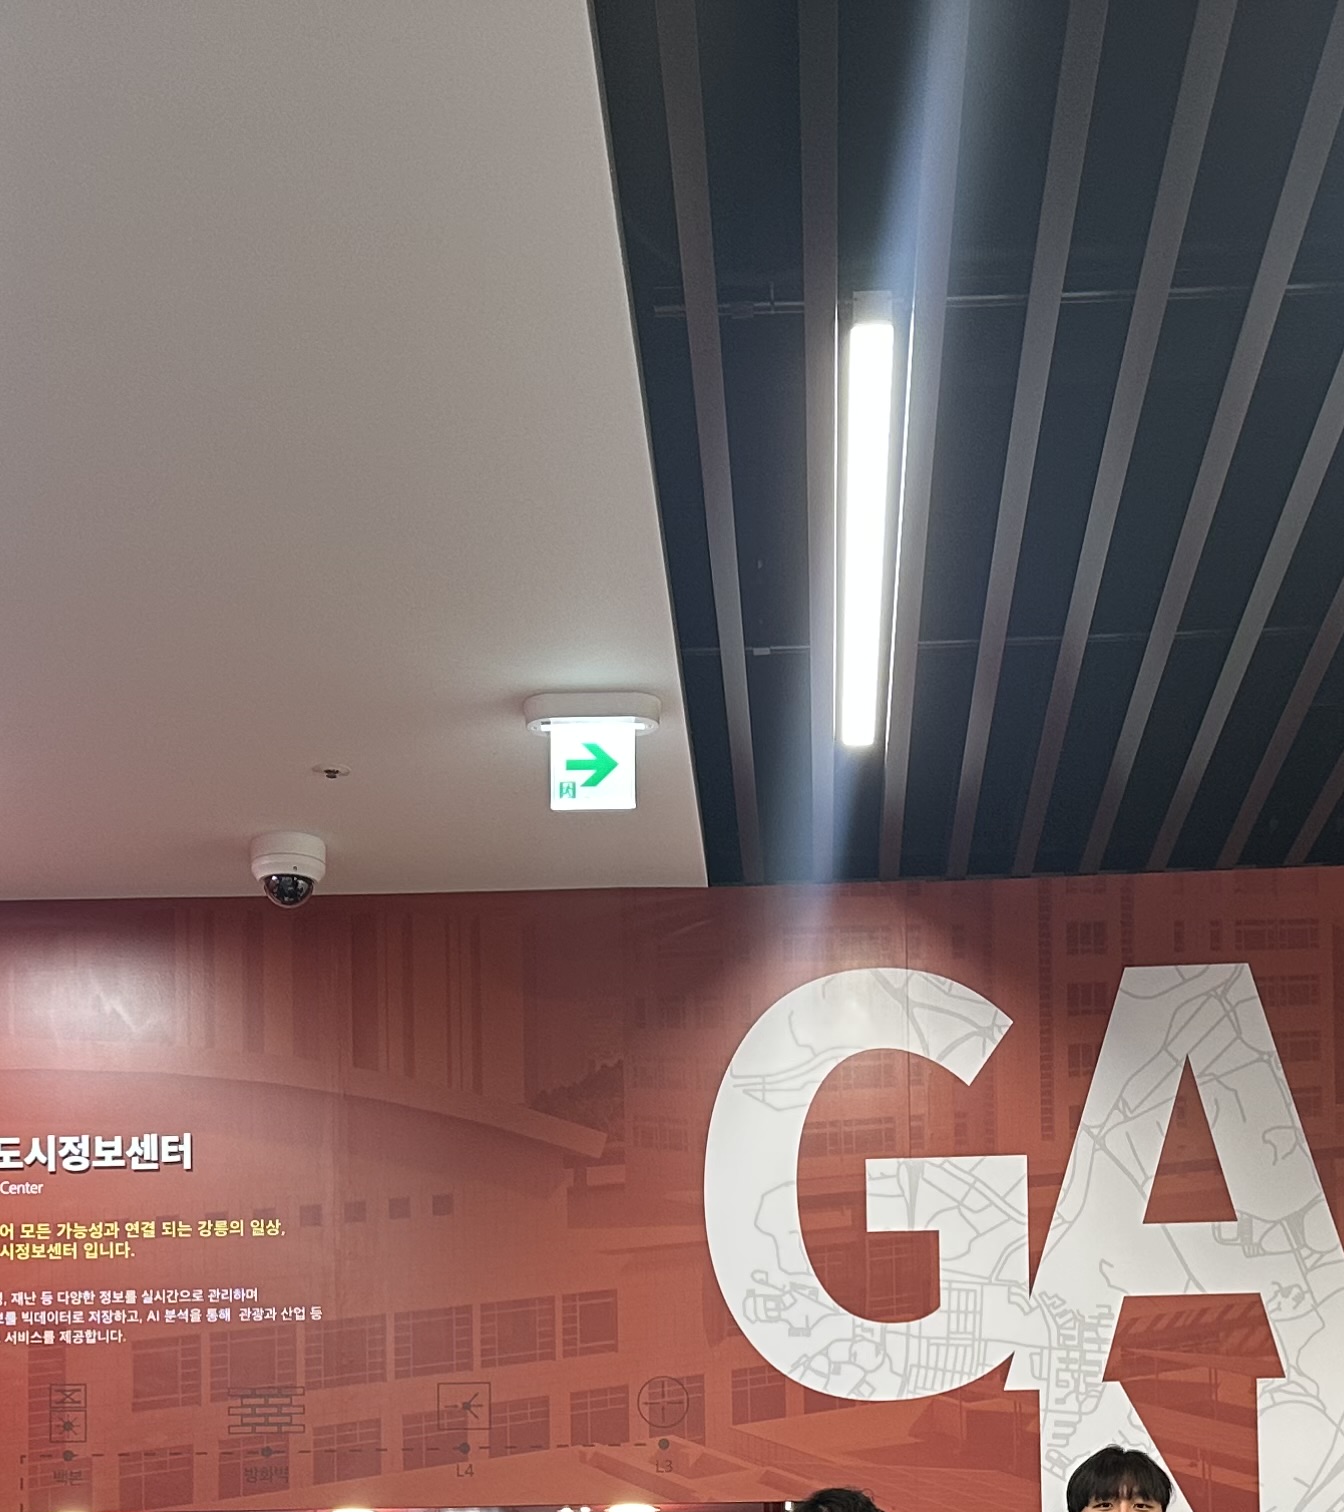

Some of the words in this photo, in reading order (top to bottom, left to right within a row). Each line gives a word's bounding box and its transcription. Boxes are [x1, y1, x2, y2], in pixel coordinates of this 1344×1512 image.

[0, 1180, 44, 1195] Center
[20, 1223, 52, 1240] 모든
[57, 1221, 119, 1240] 가능성과
[124, 1221, 156, 1239] 연결
[161, 1221, 193, 1238] 되는
[198, 1220, 244, 1237] 강릉의
[250, 1219, 286, 1237] 일상,
[84, 1241, 136, 1259] 입니다.
[11, 1291, 36, 1306] 재난
[40, 1291, 53, 1306] 등
[57, 1290, 95, 1306] 다양한
[99, 1290, 137, 1304] 정보를
[142, 1289, 204, 1304] 실시간으로
[208, 1288, 258, 1303] 관리하며
[21, 1310, 85, 1325] 빅데이터로
[88, 1310, 143, 1325] 저장하고,
[147, 1310, 160, 1322] AI
[165, 1308, 202, 1323] 분석을
[206, 1308, 231, 1322] 통해
[239, 1307, 277, 1322] 관광과
[281, 1306, 305, 1321] 산업
[310, 1306, 323, 1321] 등
[5, 1330, 55, 1345] 서비스를
[59, 1329, 127, 1344] 제공합니다.
[456, 1464, 474, 1477] L4
[656, 1460, 673, 1473] L3
